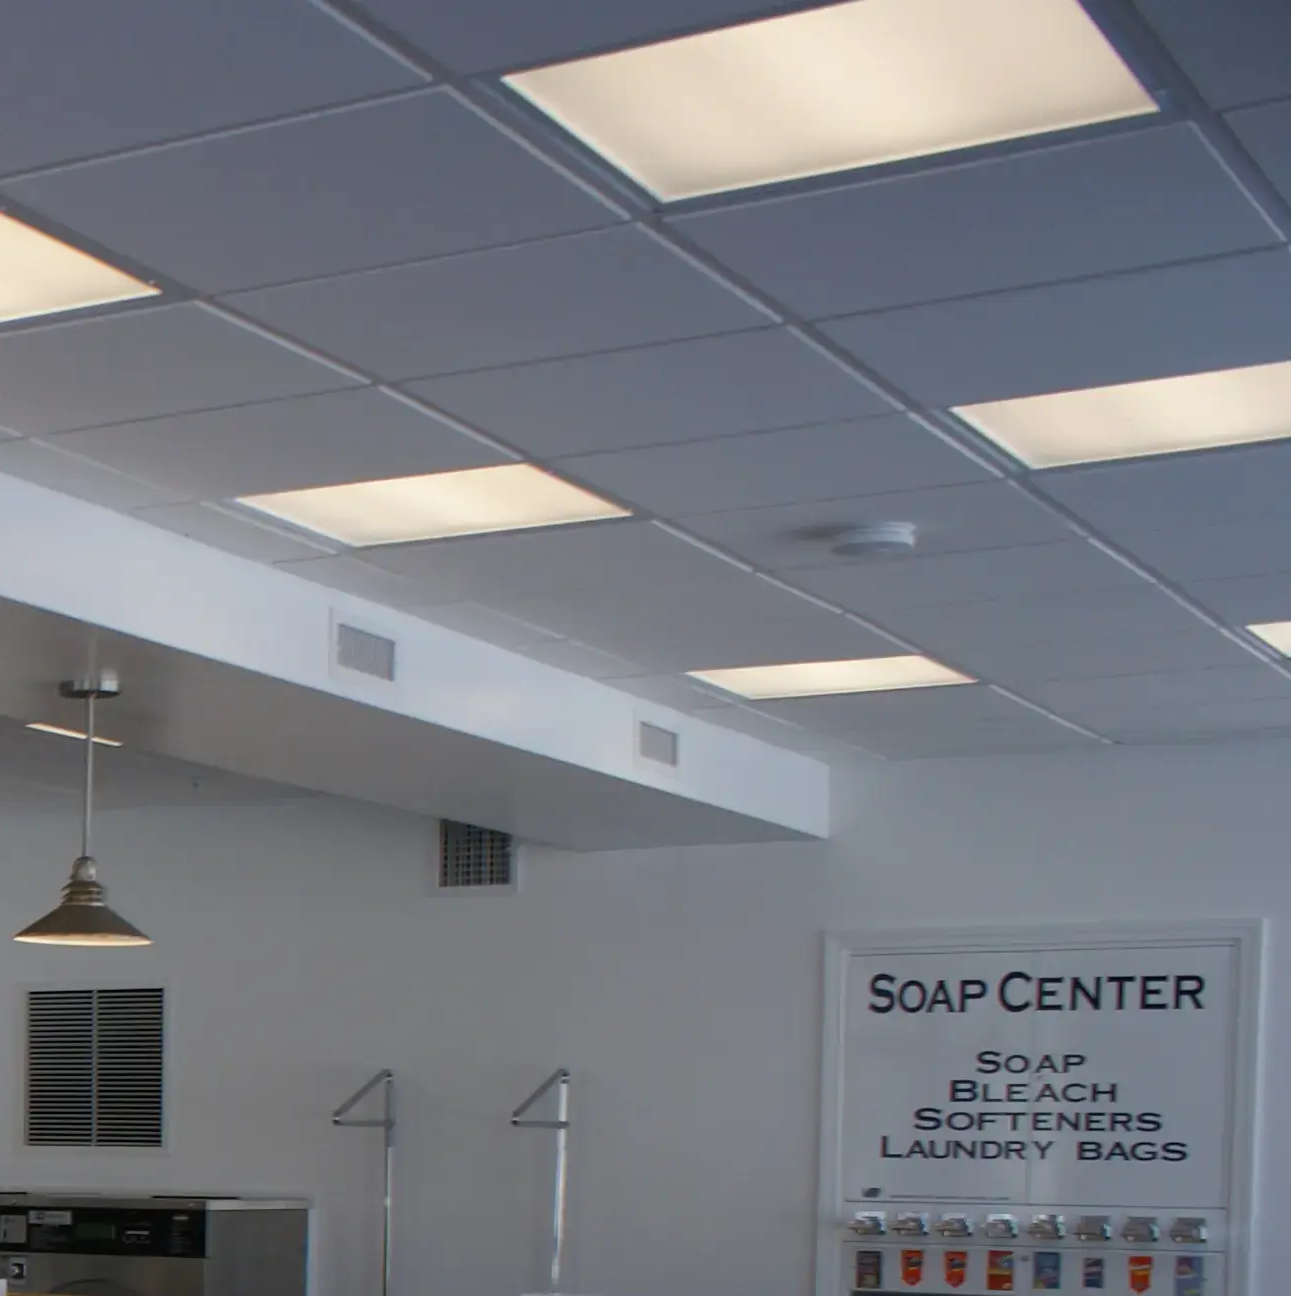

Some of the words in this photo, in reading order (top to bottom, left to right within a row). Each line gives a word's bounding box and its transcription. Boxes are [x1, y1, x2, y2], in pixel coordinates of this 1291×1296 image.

[868, 973, 988, 1013] SOAP
[998, 971, 1205, 1012] CENTER
[976, 1051, 1086, 1073] SOAP
[949, 1079, 1117, 1102] BLEACH
[913, 1108, 1162, 1131] SOFTENERS
[880, 1136, 1054, 1159] LAUNDRY
[1076, 1142, 1188, 1162] BAGS
